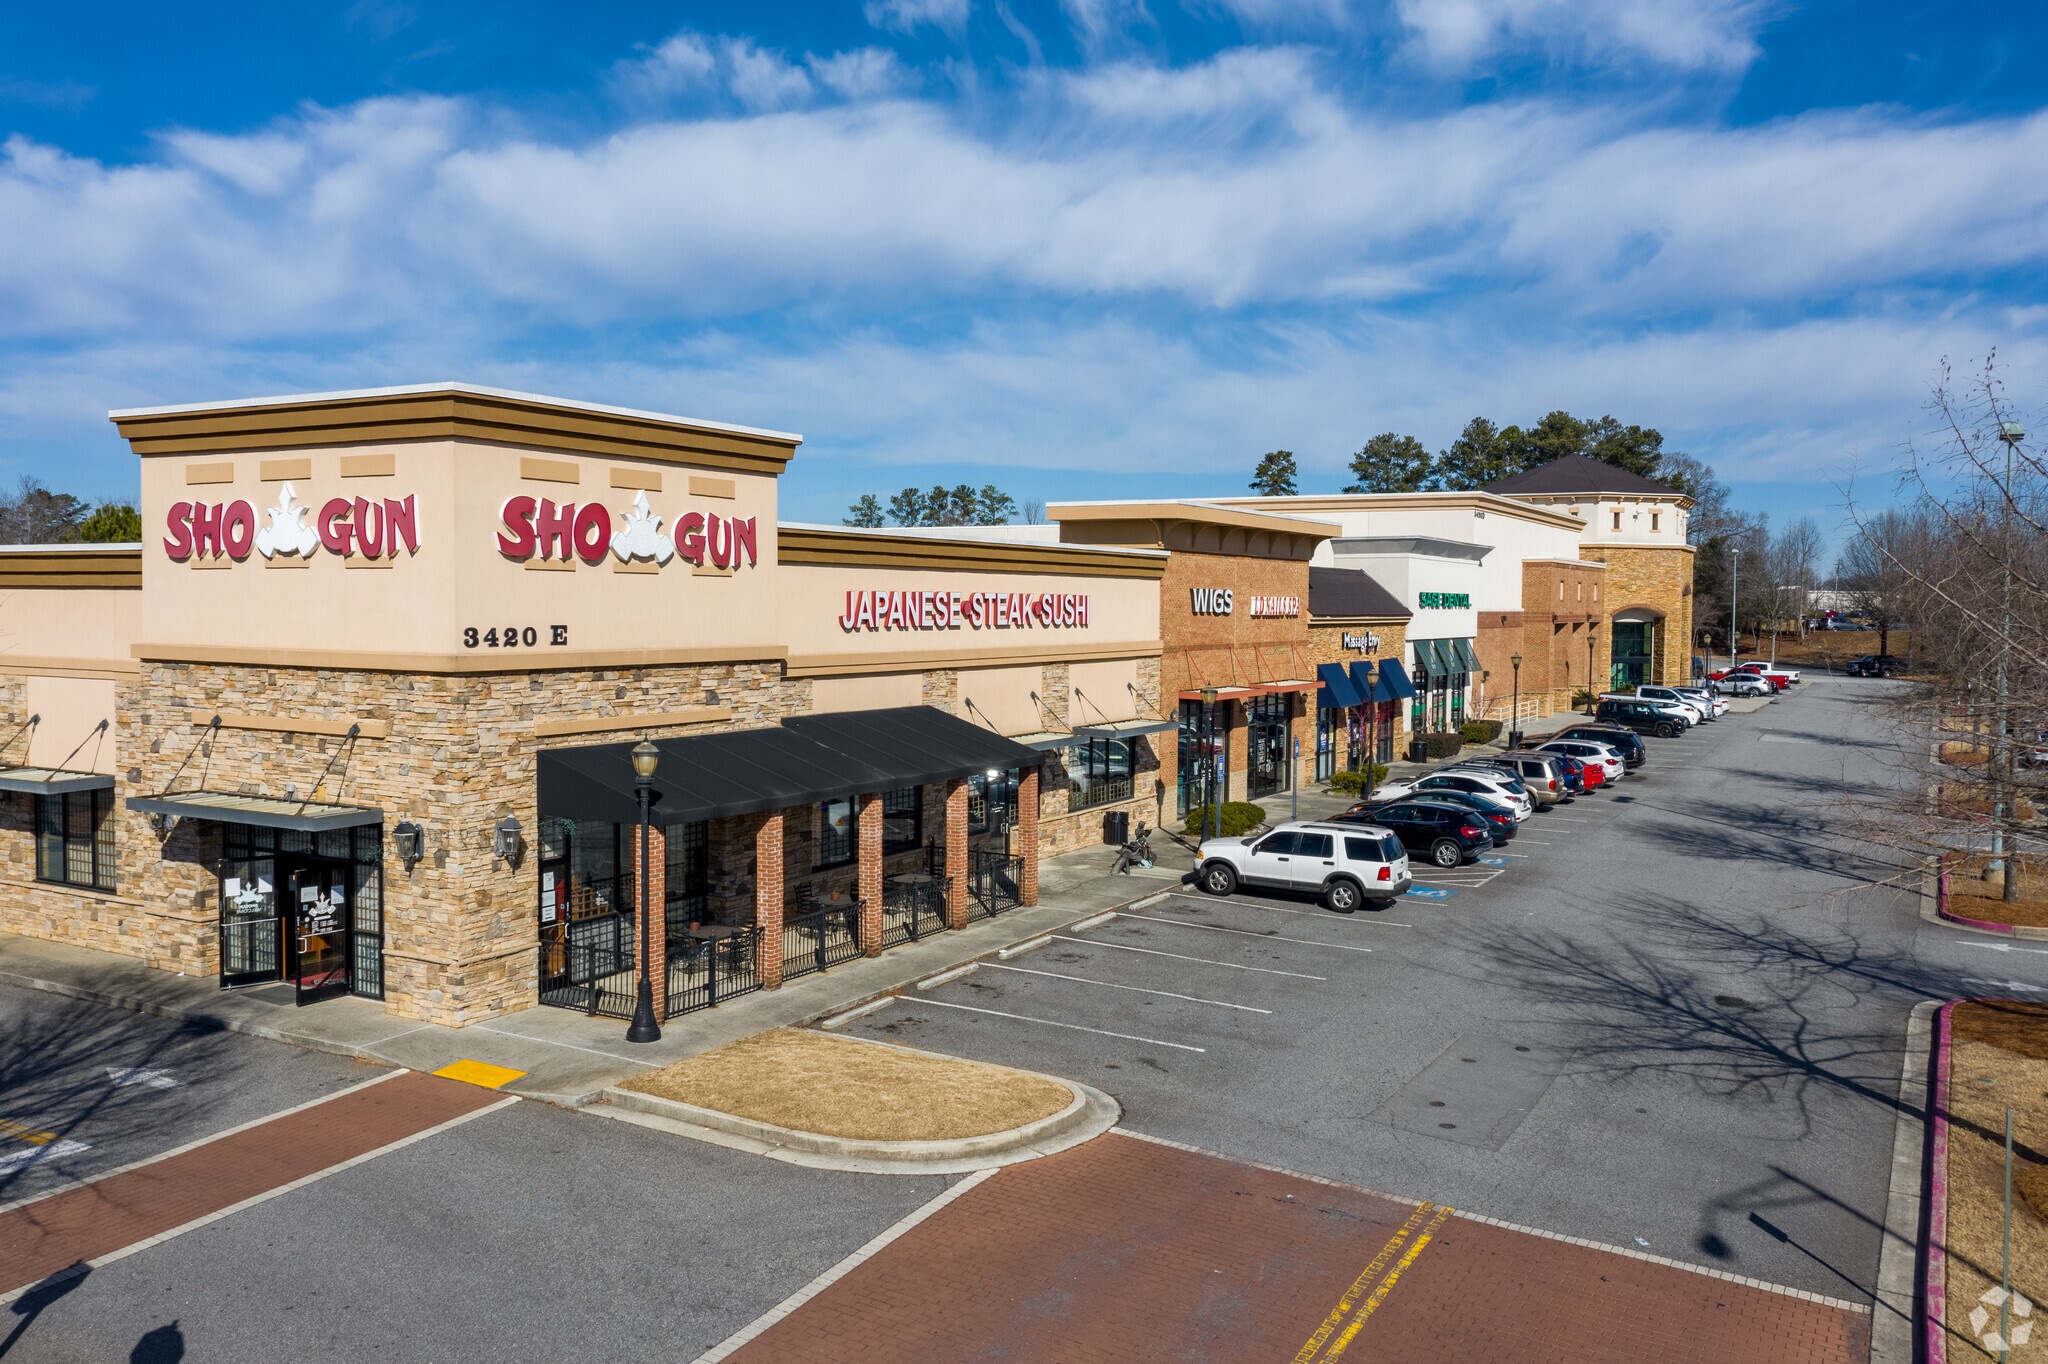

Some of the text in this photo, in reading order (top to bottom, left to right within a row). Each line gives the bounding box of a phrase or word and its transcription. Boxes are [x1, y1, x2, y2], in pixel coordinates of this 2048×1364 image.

[163, 493, 422, 559] SHO GUN
[494, 495, 757, 568] SHO GUN
[839, 590, 1091, 630] JAPANESE STEAK SUSHI
[1191, 588, 1234, 613] WIGS
[1264, 596, 1287, 615] NAILS
[1287, 597, 1300, 615] SPA
[1420, 592, 1472, 607] SAGE DENTAL
[463, 624, 568, 648] 3420 E
[1343, 631, 1380, 652] Massage Envy
